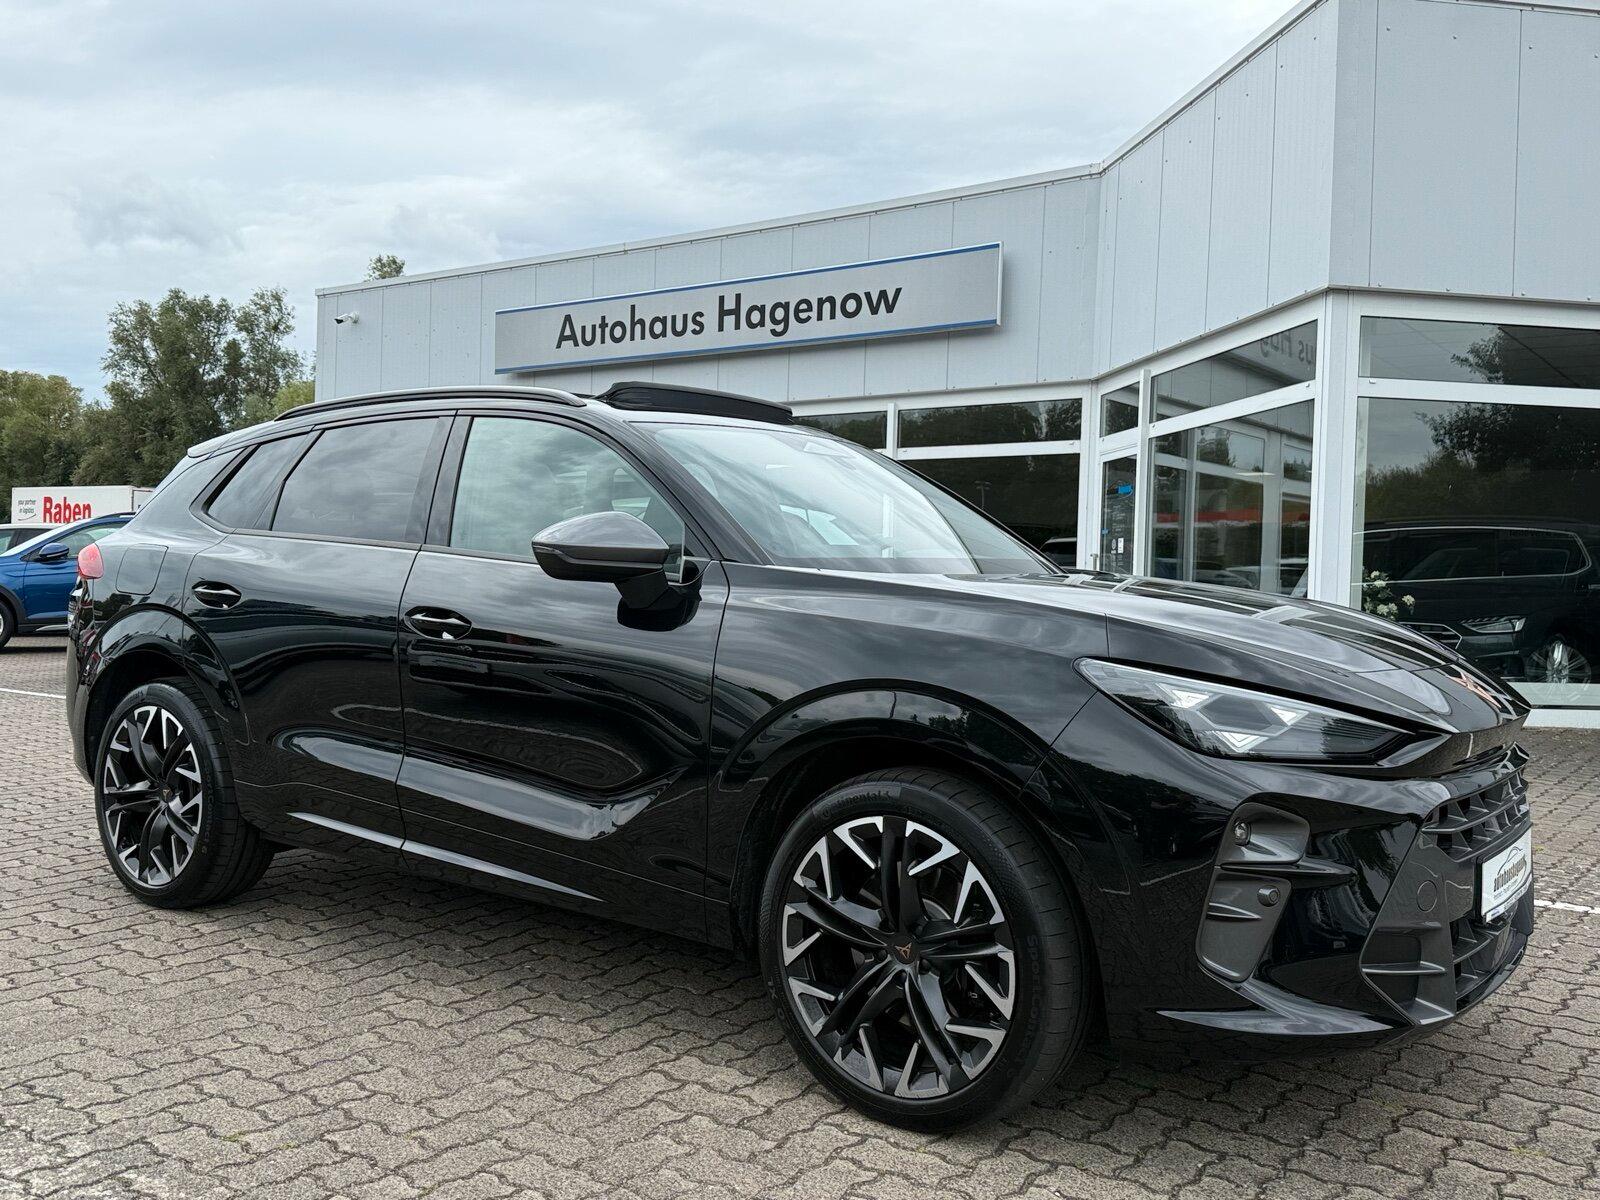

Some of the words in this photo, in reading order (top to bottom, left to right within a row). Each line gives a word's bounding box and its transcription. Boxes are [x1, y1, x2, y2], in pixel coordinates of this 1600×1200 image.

[556, 304, 704, 349] Autohaus
[718, 286, 903, 337] Hagenow
[43, 496, 92, 523] Raben
